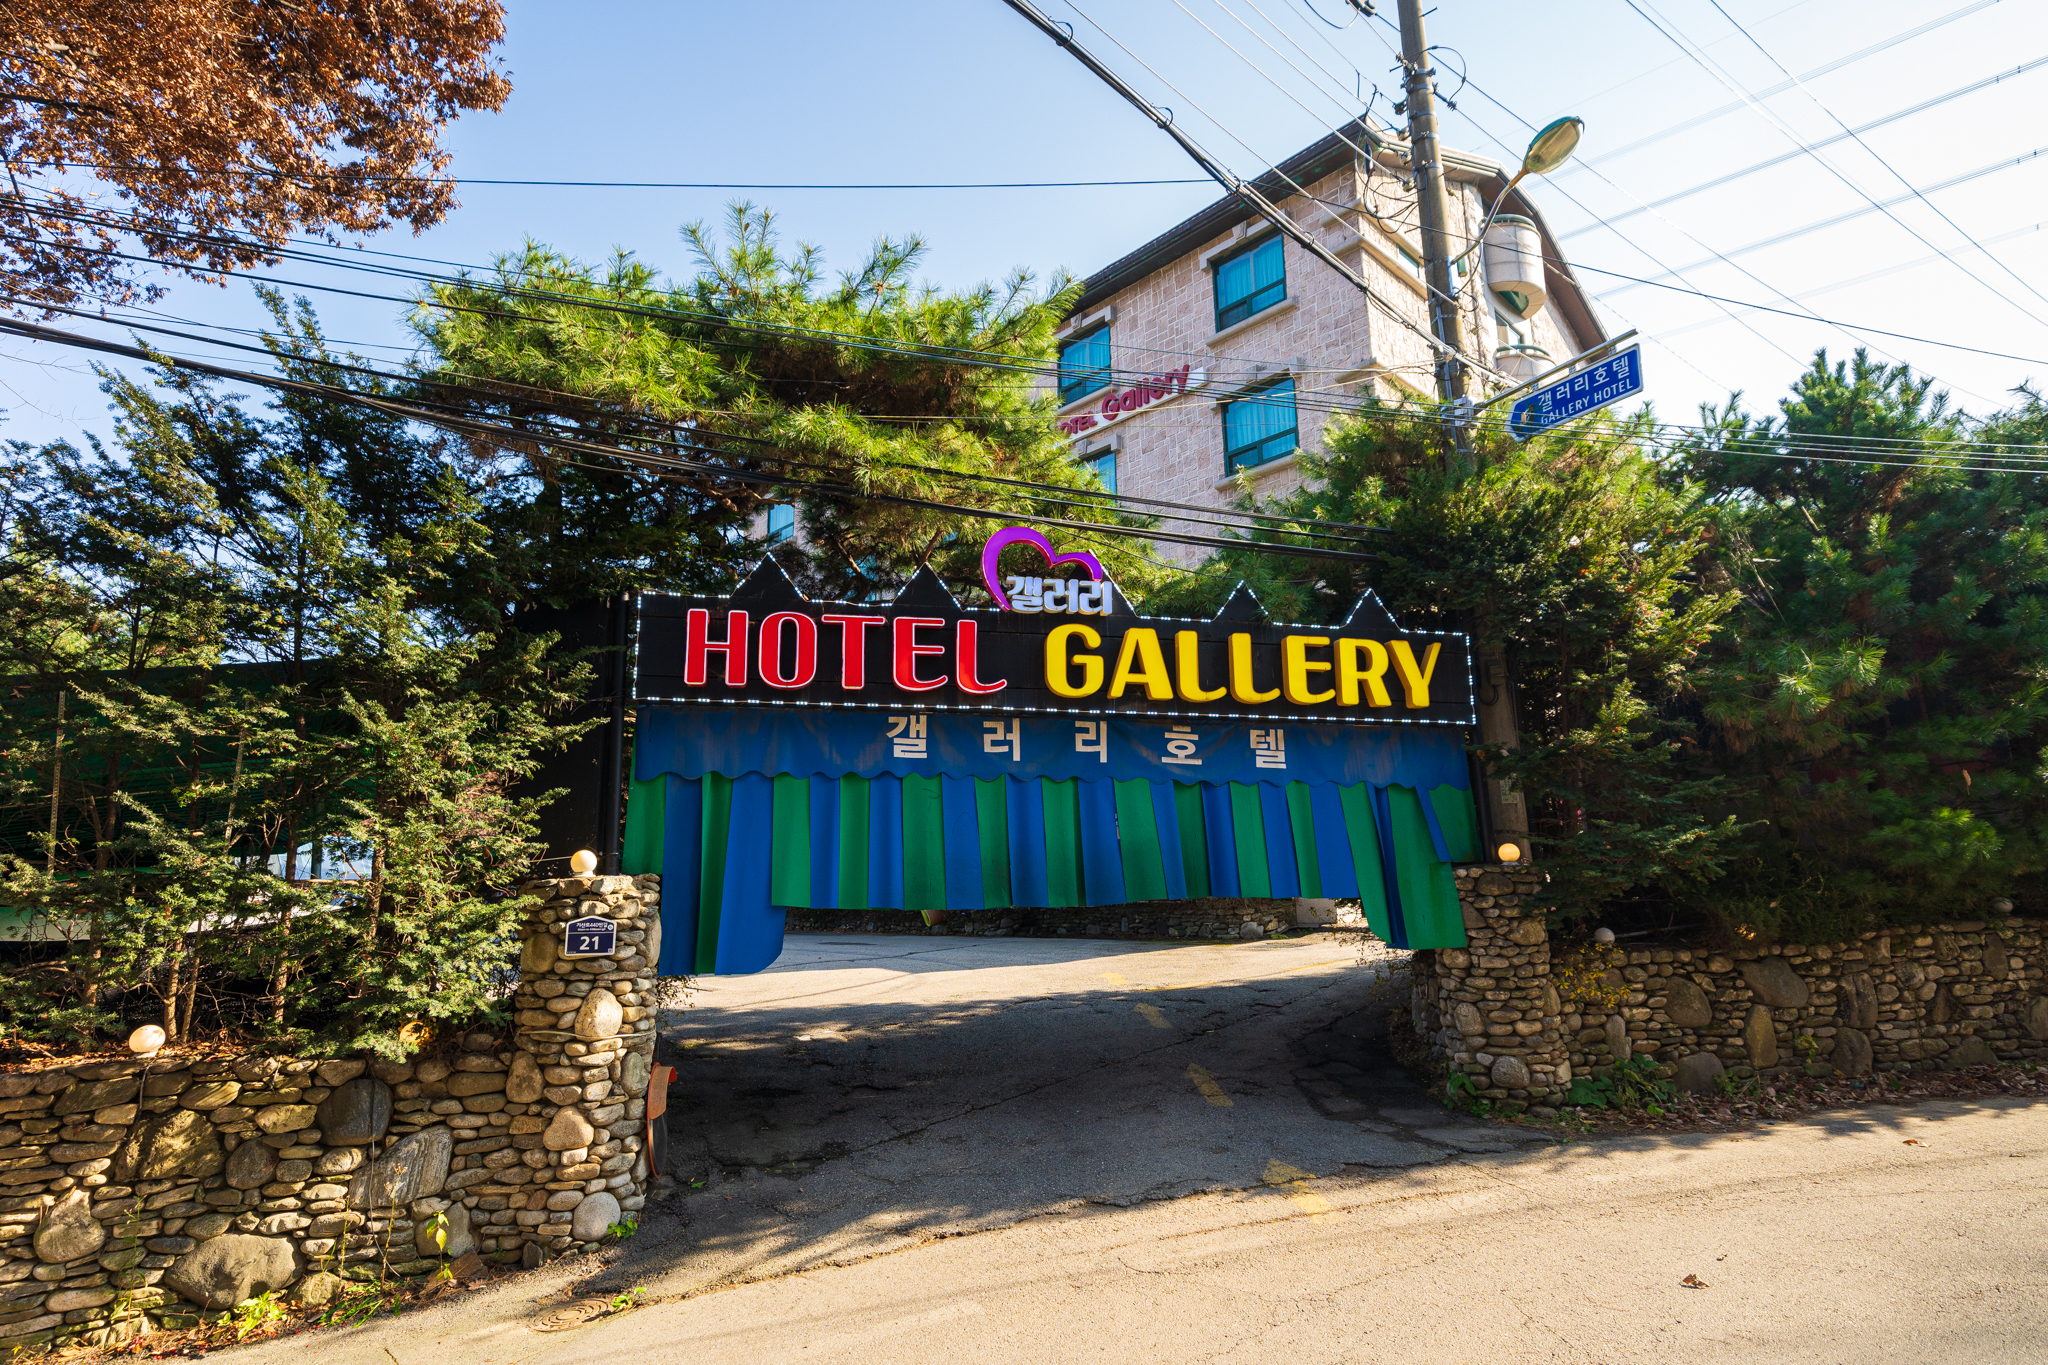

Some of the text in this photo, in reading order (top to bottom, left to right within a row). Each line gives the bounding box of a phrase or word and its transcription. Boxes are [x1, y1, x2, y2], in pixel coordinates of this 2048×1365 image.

[1056, 364, 1190, 435] OTEL Gallery
[1538, 355, 1630, 413] 갤러리호텔
[1541, 379, 1633, 425] GALLERY HOTEL
[1006, 576, 1113, 616] 갤러리
[684, 608, 1442, 709] HOTEL GALLERY
[579, 935, 599, 950] 21
